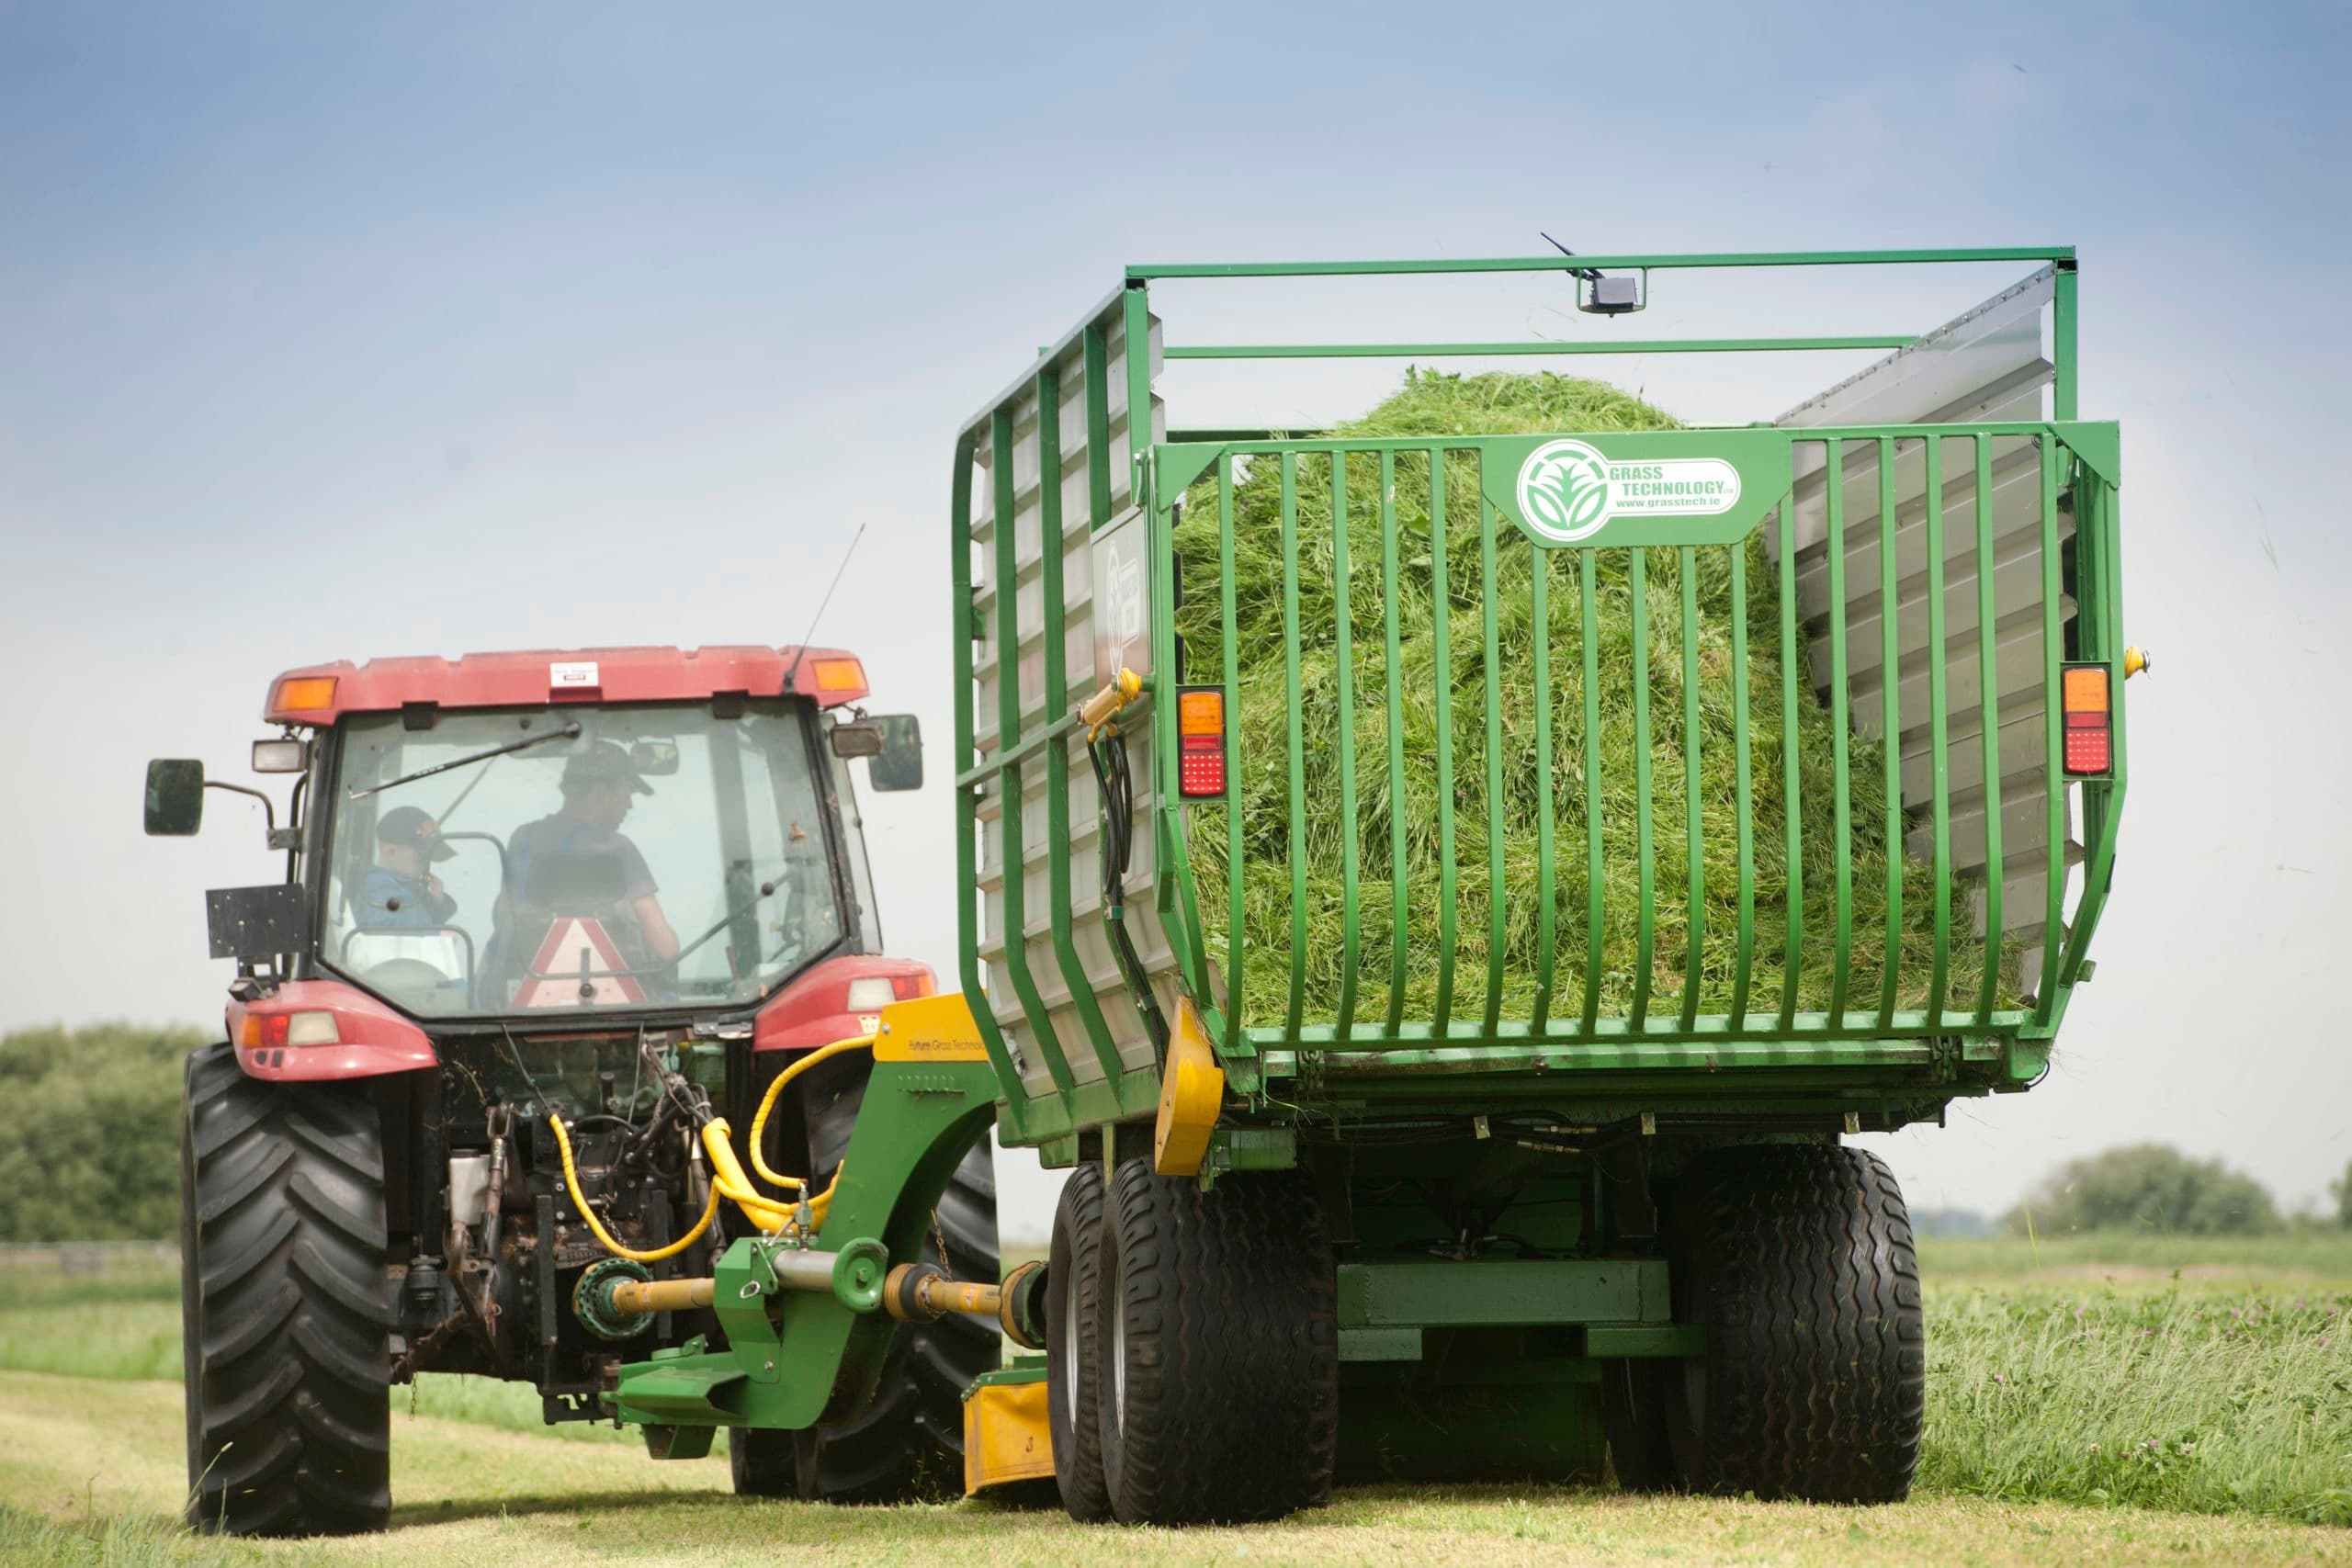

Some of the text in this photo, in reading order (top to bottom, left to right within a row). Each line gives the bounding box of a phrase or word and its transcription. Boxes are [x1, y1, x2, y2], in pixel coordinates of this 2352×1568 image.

[1610, 467, 1663, 480] GRASS
[1622, 481, 1724, 496] TECHNOLOGY
[1616, 497, 1721, 508] www.grasstech.ie
